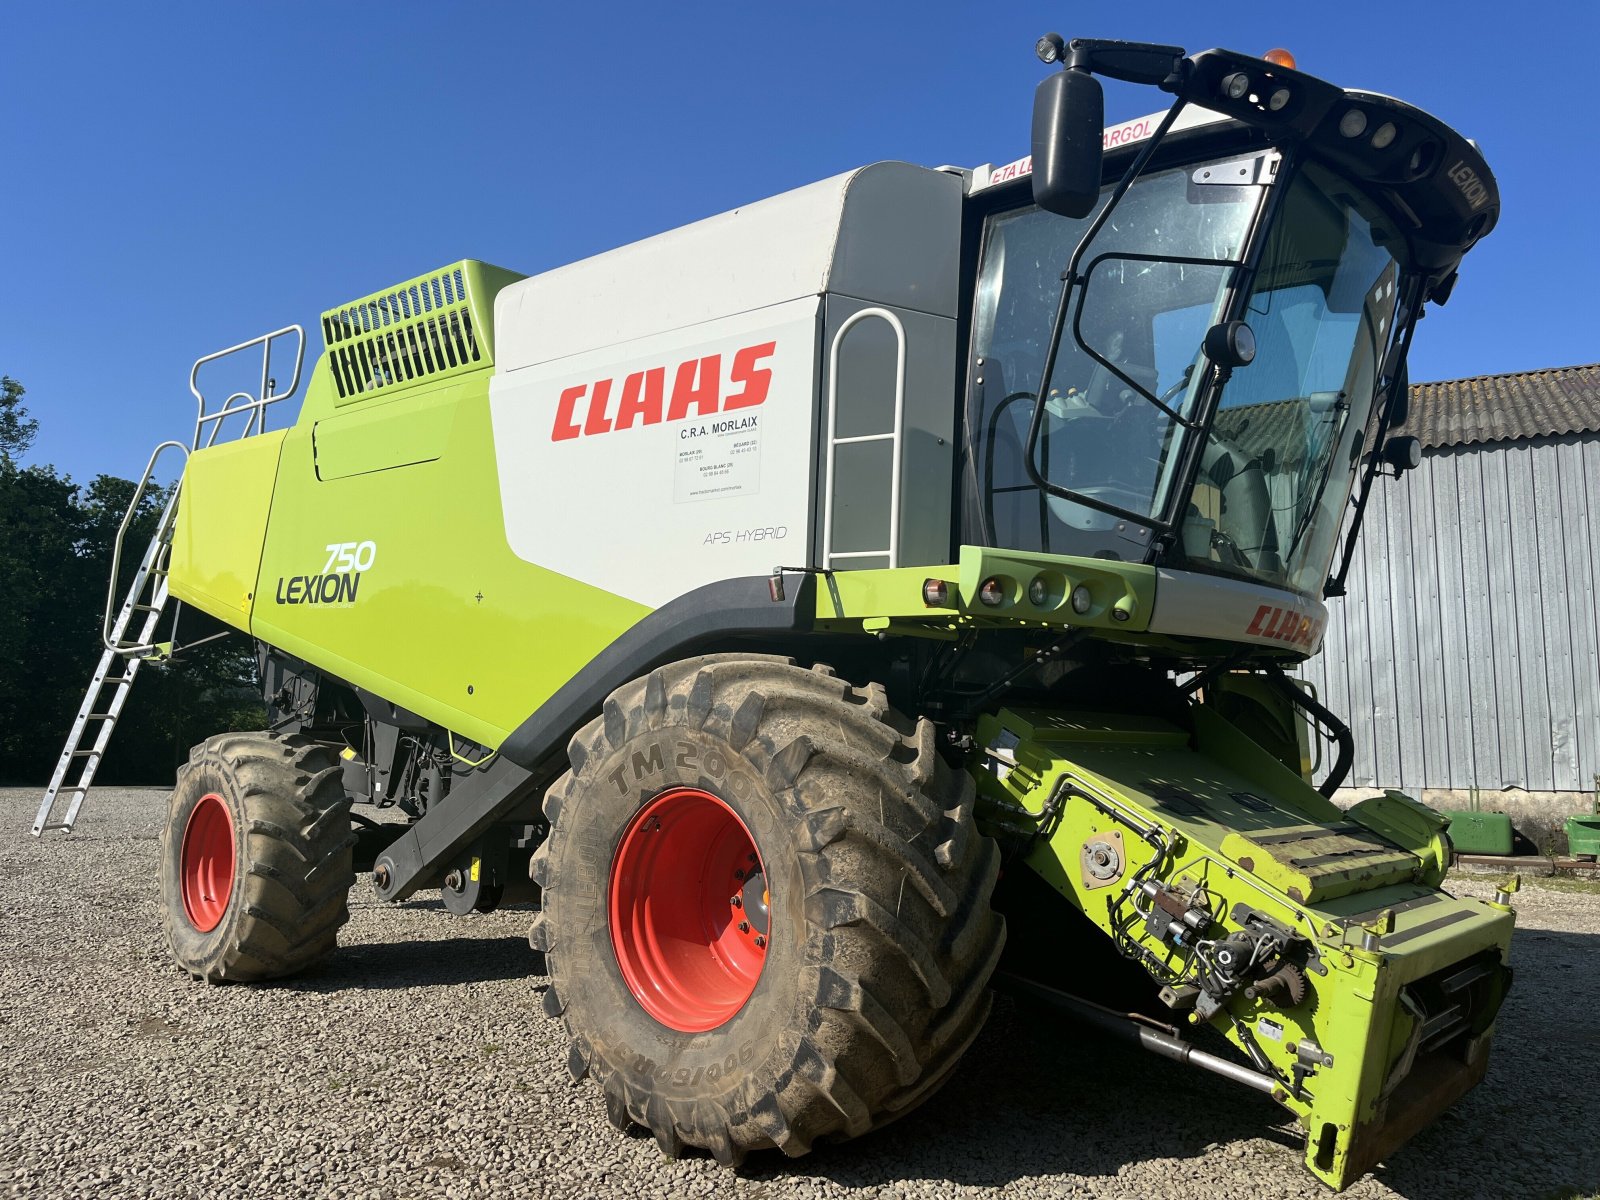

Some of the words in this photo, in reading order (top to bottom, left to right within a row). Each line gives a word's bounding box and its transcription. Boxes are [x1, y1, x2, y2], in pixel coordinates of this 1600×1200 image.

[1447, 160, 1490, 212] LEXION
[550, 340, 777, 442] CLAAS
[680, 425, 709, 439] C.R.A.
[712, 415, 758, 434] MORLAIX
[703, 531, 732, 545] APS
[735, 526, 788, 543] HYBRID
[322, 540, 376, 574] 750
[276, 572, 361, 605] LEXION
[607, 743, 665, 797] TM
